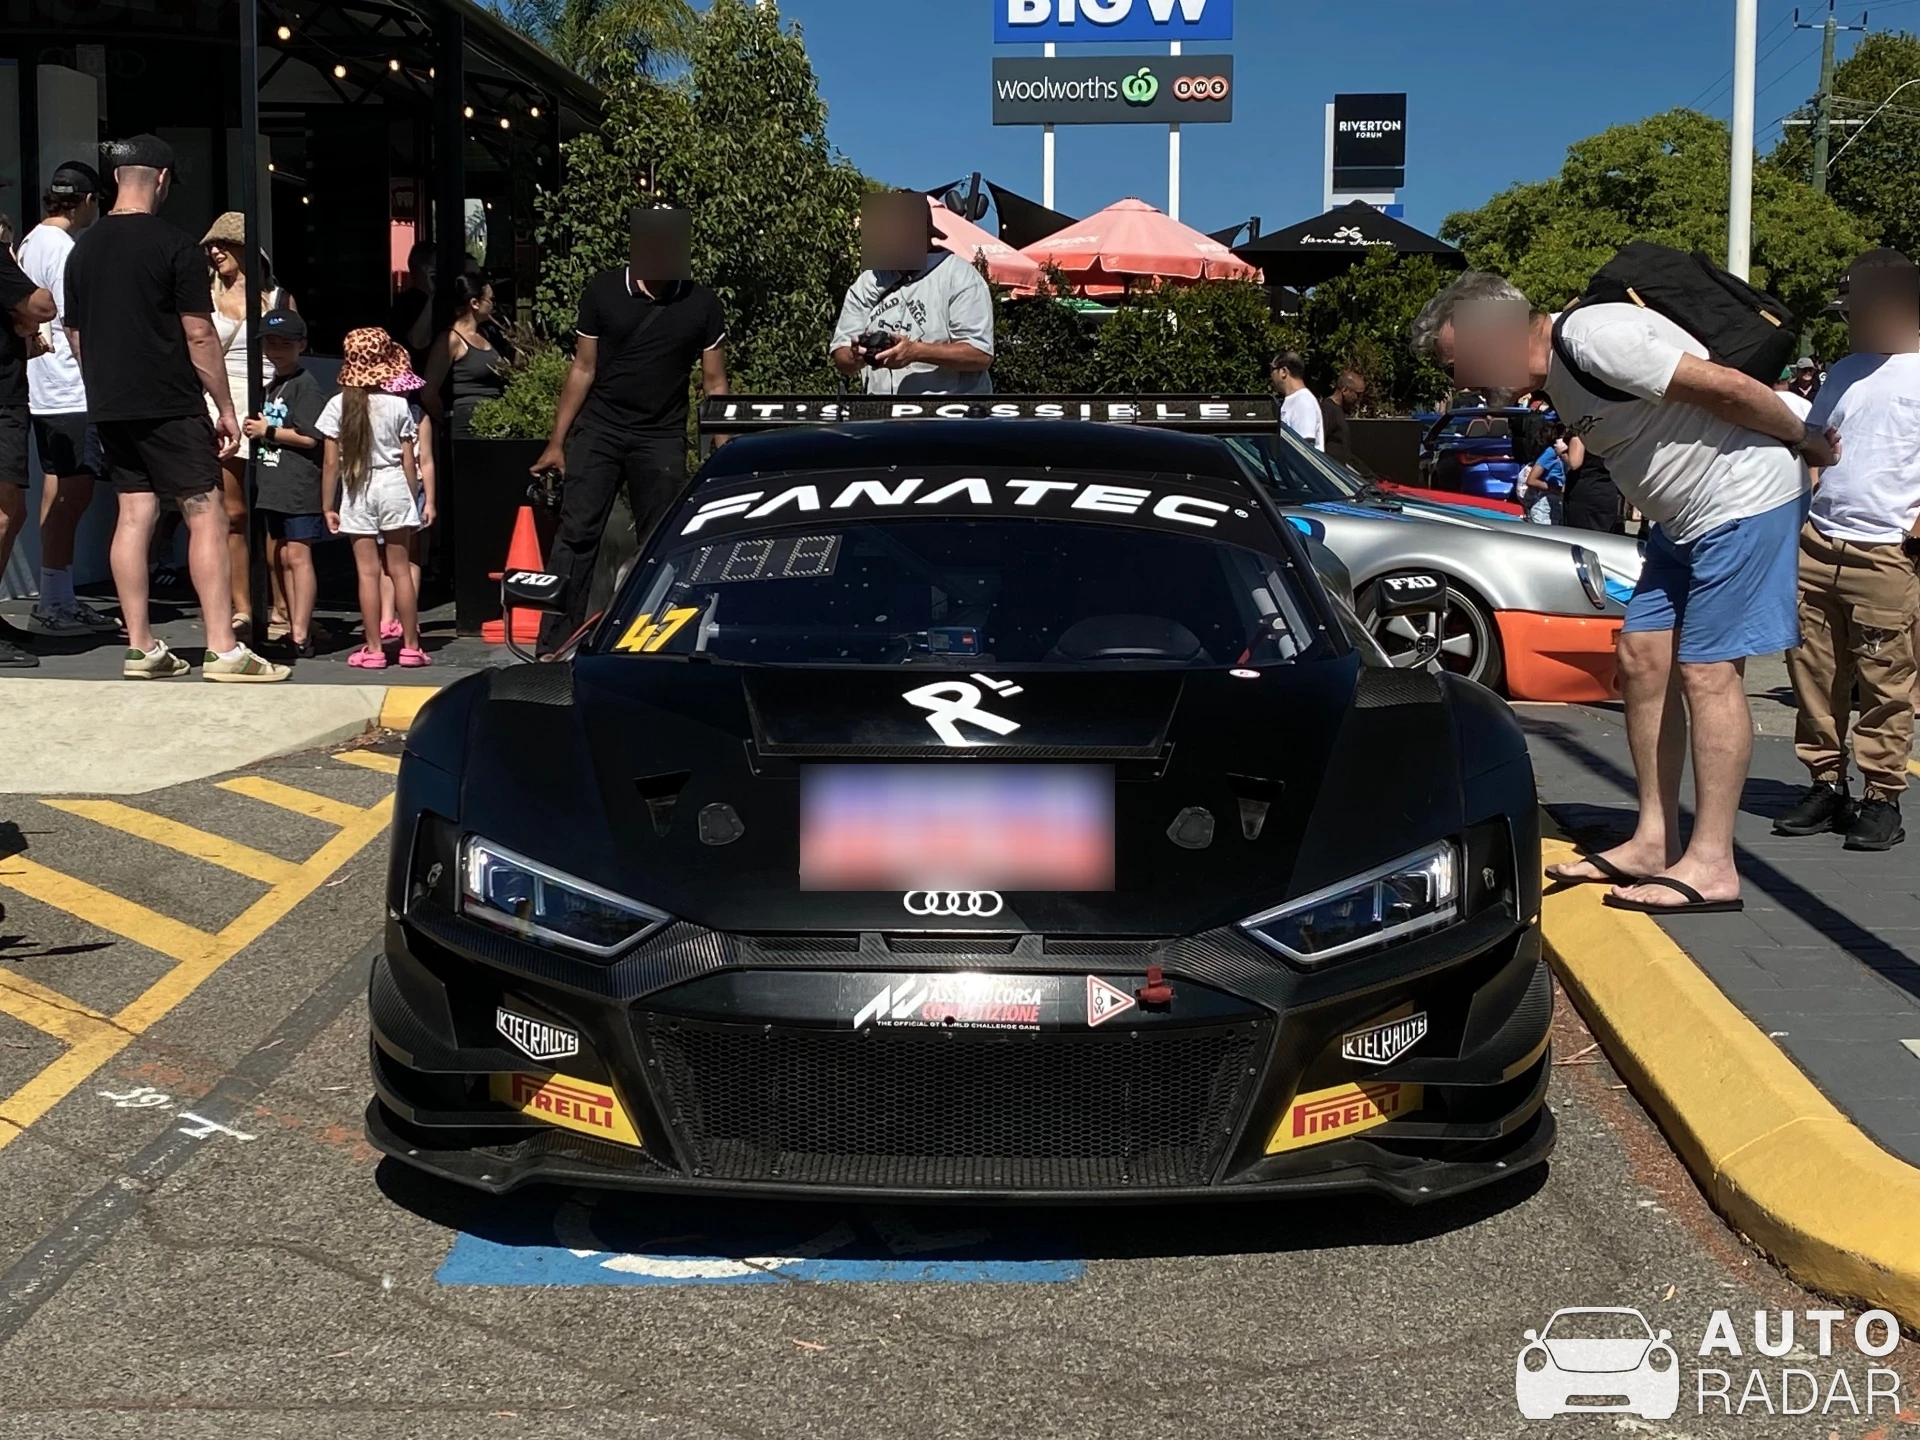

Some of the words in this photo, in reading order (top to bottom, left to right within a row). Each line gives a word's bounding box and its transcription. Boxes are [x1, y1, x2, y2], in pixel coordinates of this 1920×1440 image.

[997, 75, 1118, 100] Woolworths
[1339, 120, 1401, 132] RIVERTON
[615, 606, 700, 652] 47
[512, 1073, 614, 1129] PIRELLI
[1292, 1083, 1400, 1138] PIRELLI
